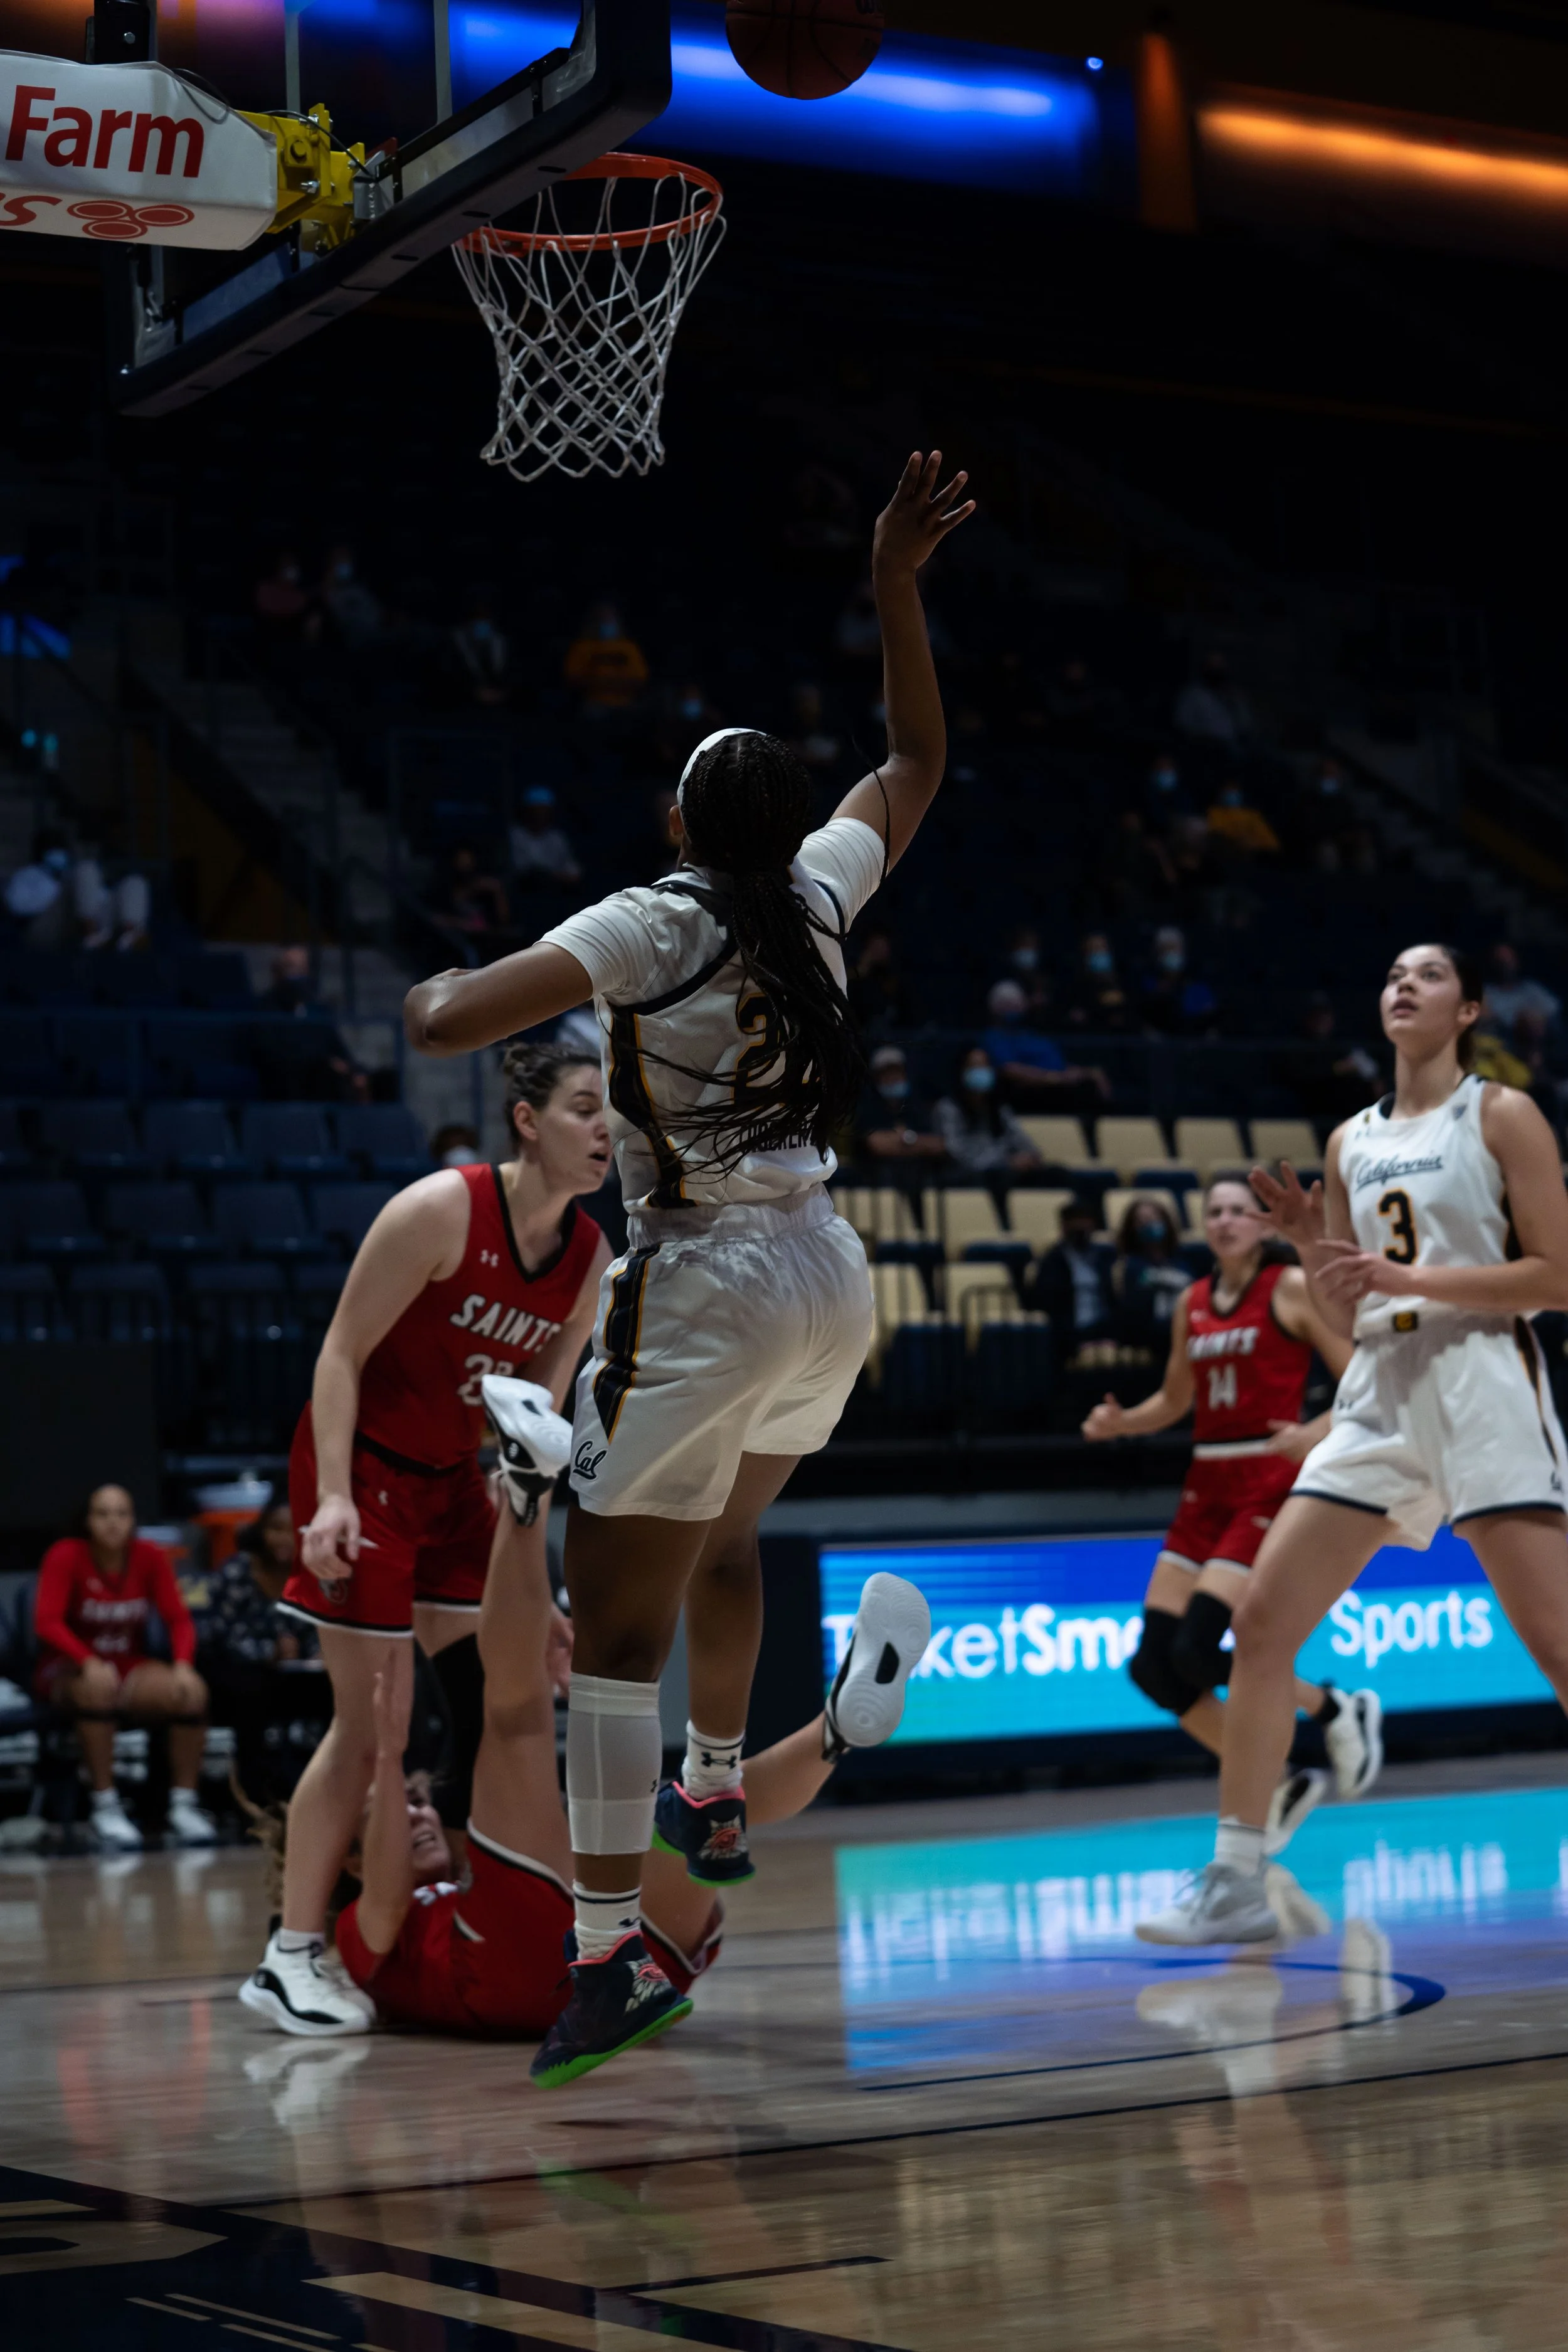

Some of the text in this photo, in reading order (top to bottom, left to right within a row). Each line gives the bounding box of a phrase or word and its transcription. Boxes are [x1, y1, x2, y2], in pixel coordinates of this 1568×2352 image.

[5, 85, 204, 177] Farm
[1379, 1189, 1417, 1264] 3
[448, 1293, 563, 1354] SAINTS
[456, 1352, 515, 1407] 2
[573, 1440, 607, 1480] Cal
[820, 1589, 1495, 1679] TketSm Sports
